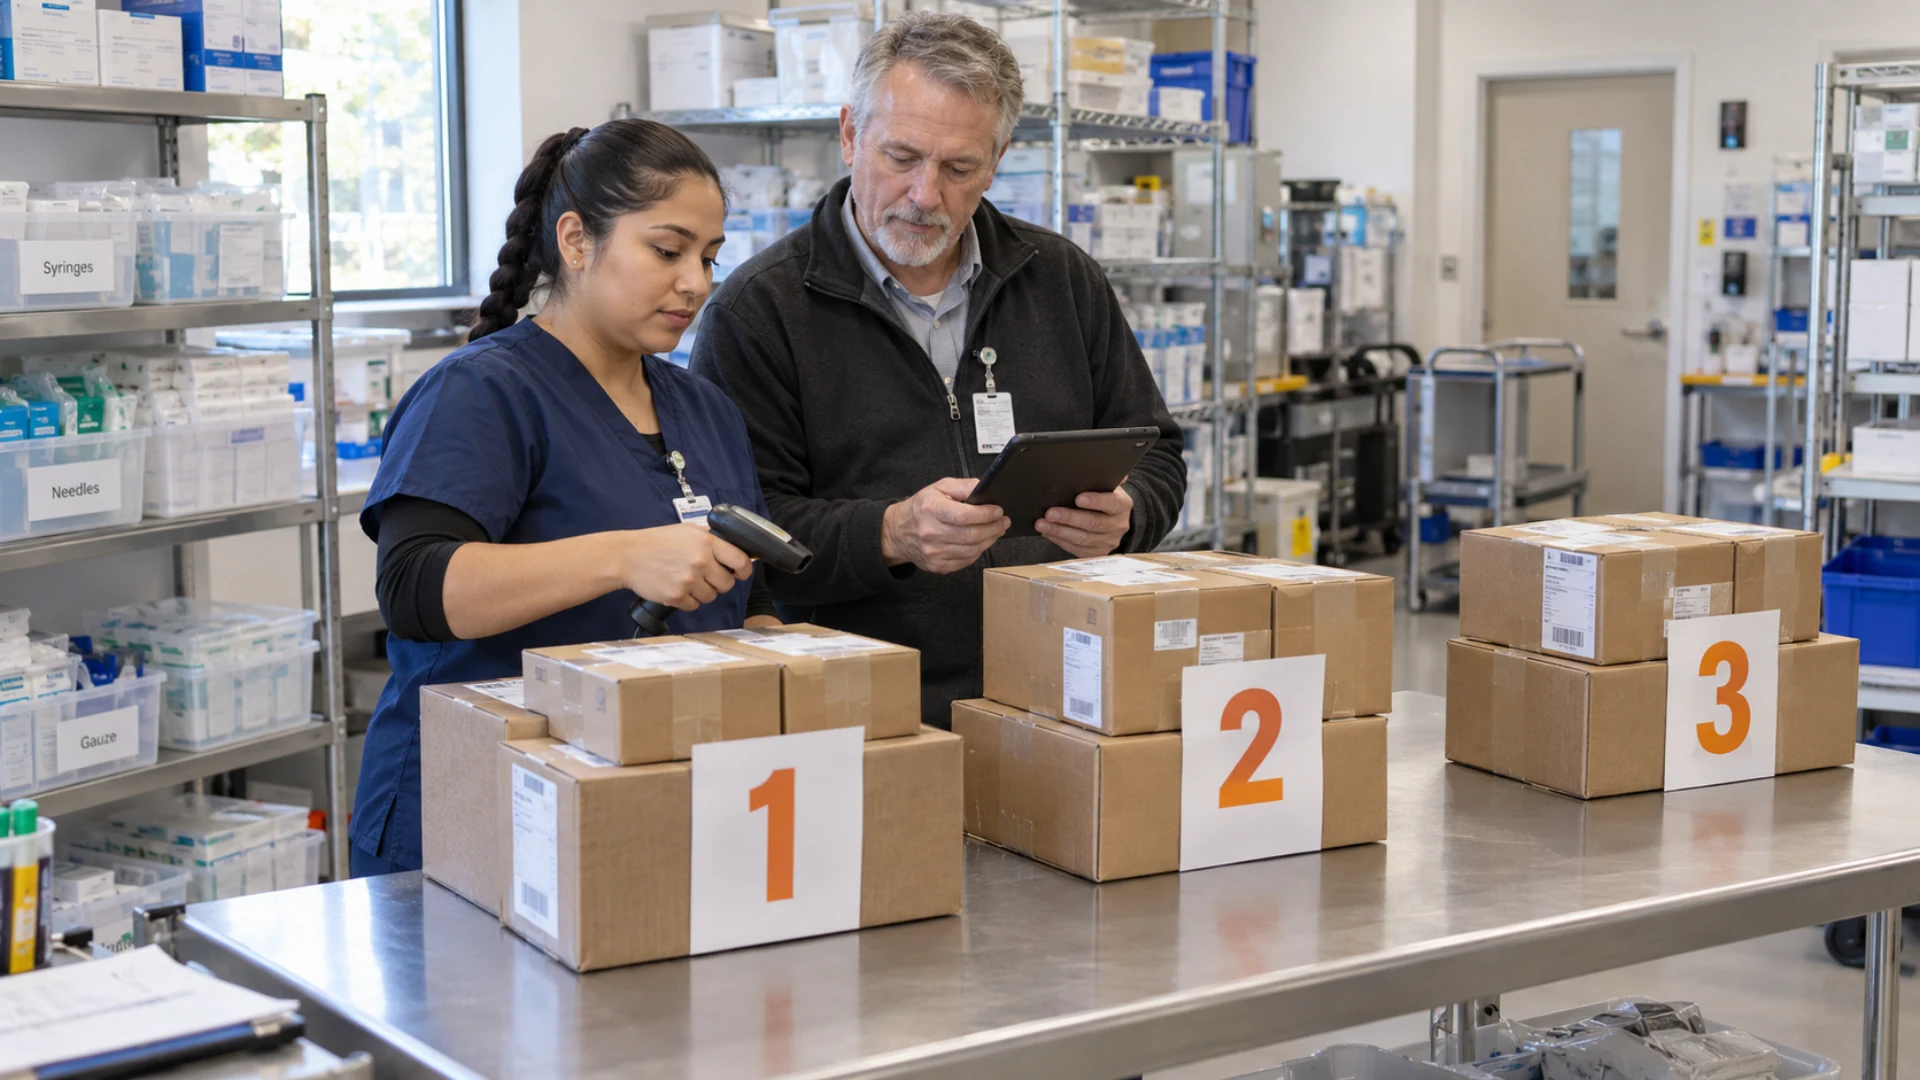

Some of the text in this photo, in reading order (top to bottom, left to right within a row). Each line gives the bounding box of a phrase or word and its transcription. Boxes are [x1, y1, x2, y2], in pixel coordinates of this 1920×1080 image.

[43, 260, 94, 278] Syringes
[51, 482, 100, 500] Needles
[1696, 641, 1750, 754] 3
[80, 732, 117, 750] Gauze
[1219, 689, 1283, 808] 2
[749, 768, 794, 901] 1
